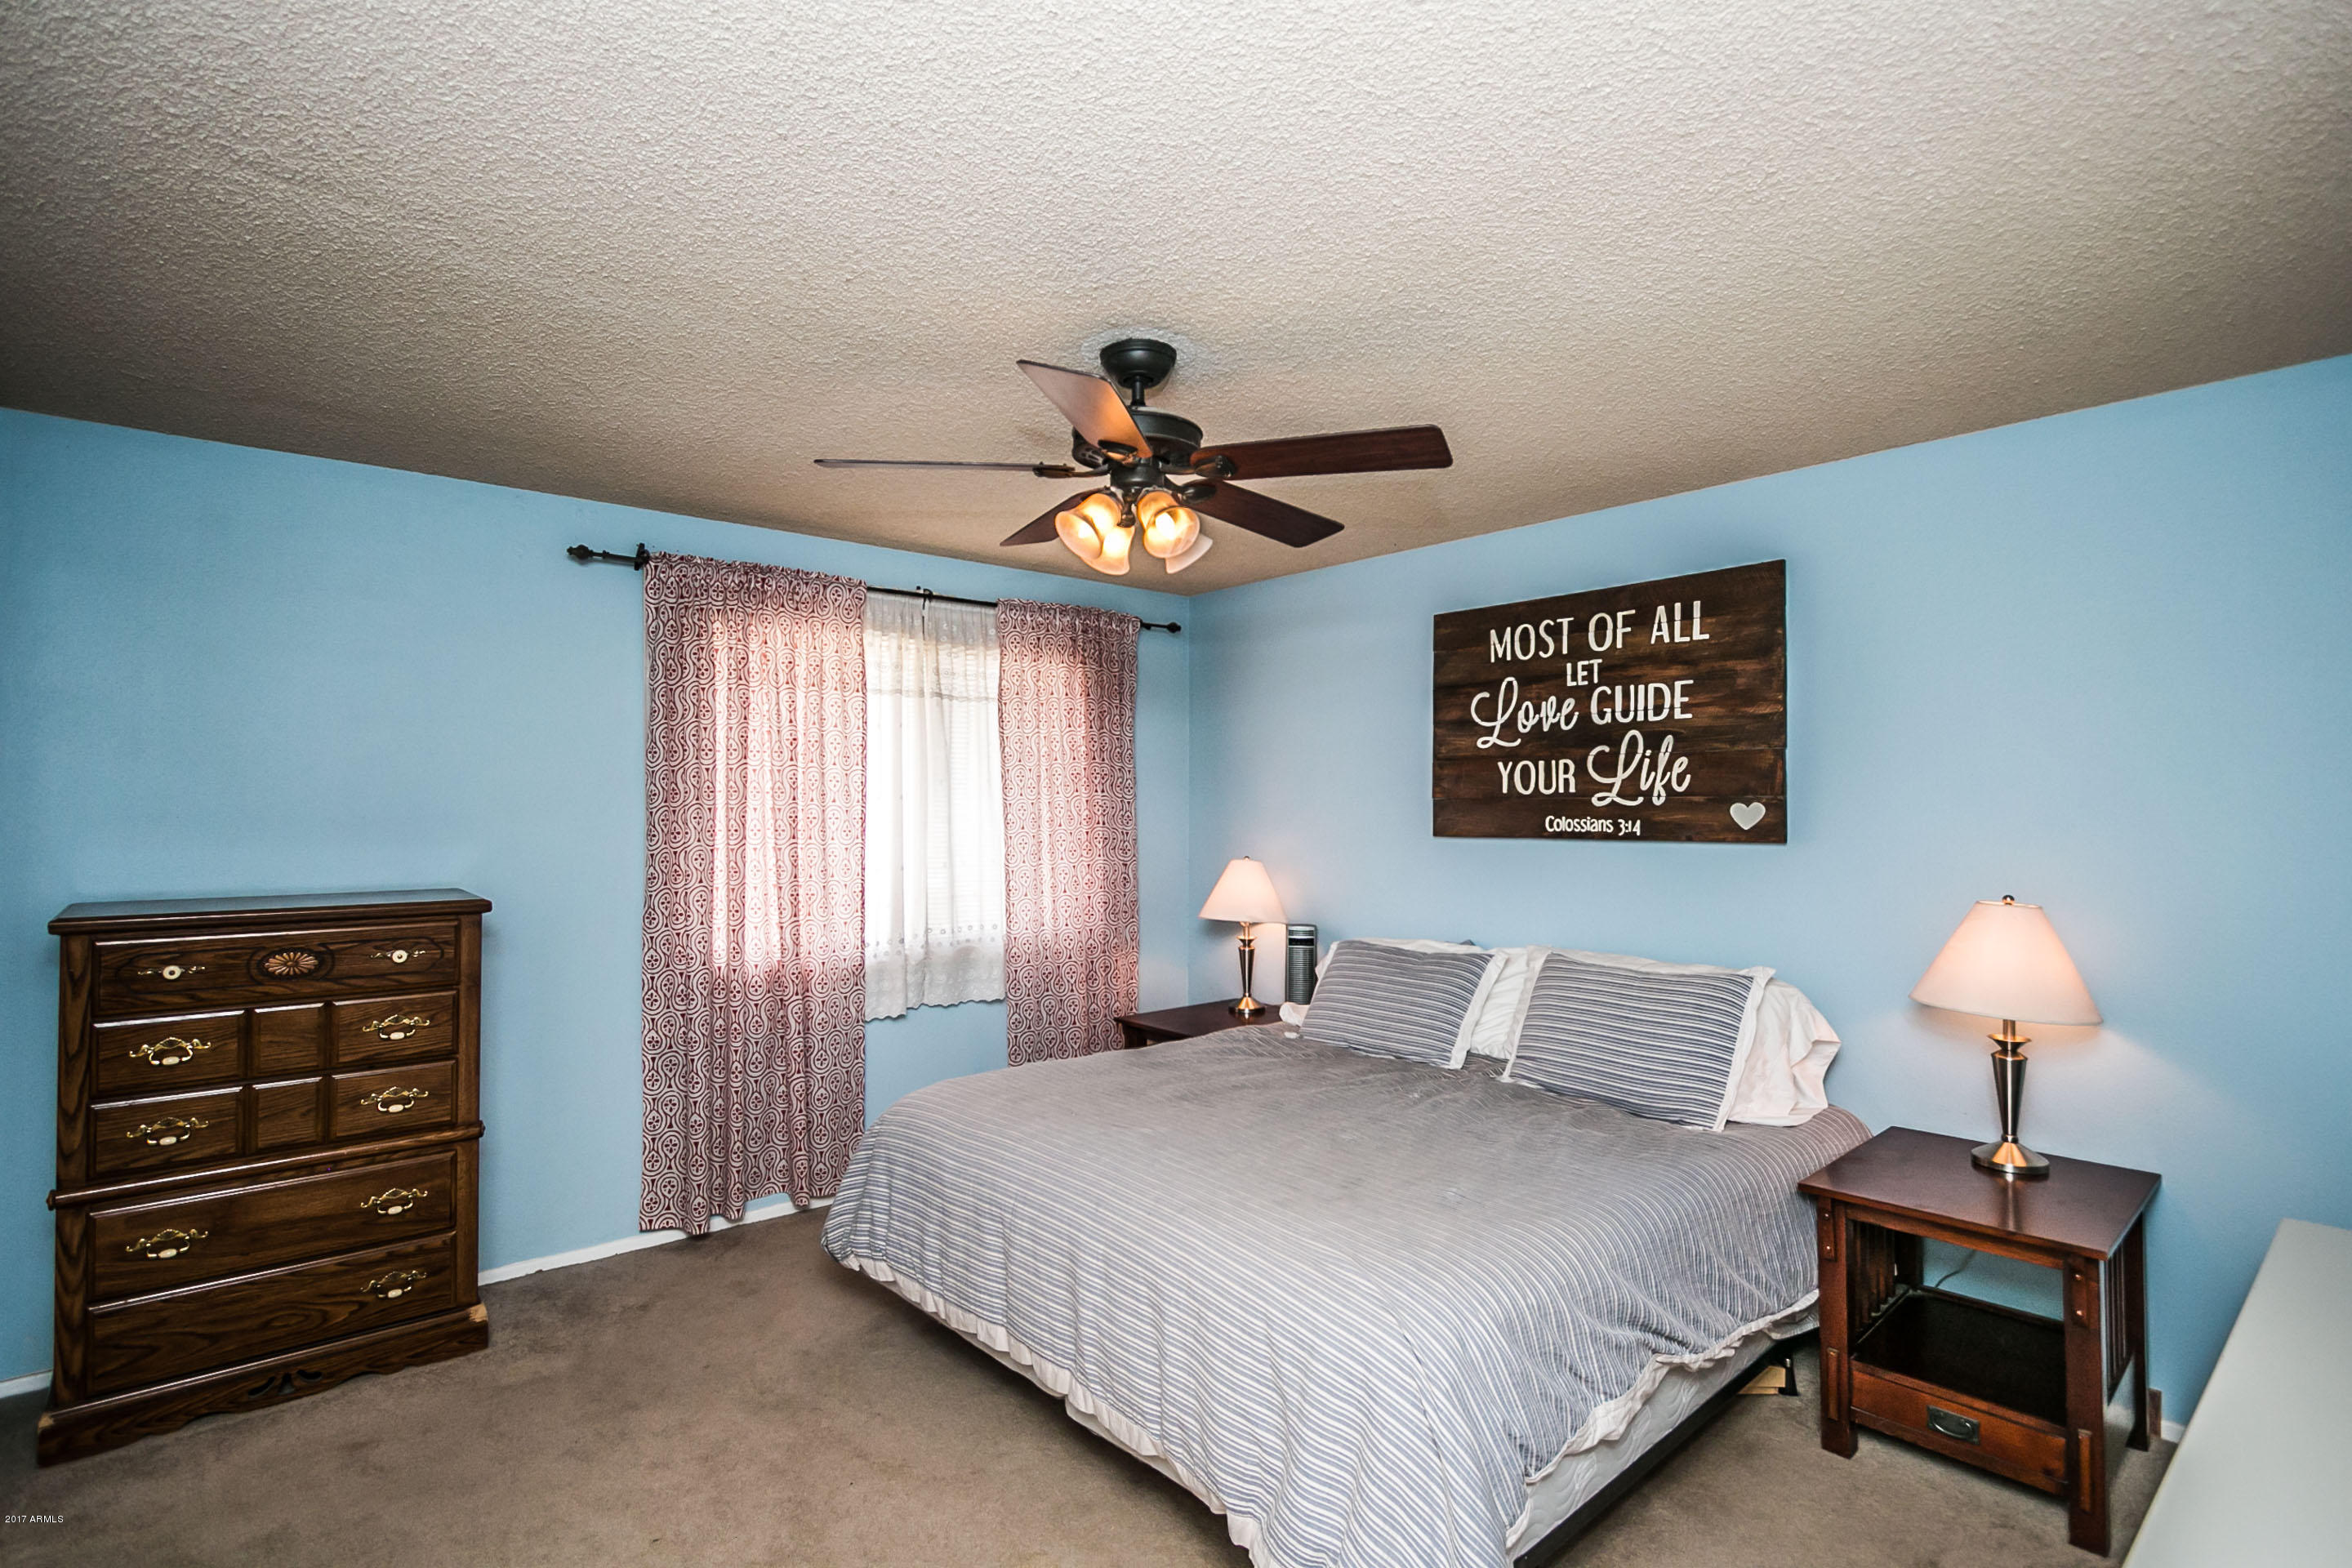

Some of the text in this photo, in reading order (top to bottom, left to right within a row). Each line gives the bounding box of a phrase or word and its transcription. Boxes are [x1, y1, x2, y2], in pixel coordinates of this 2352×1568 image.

[1490, 600, 1710, 663] MOST OF ALL
[1566, 659, 1603, 687] LET
[1470, 677, 1694, 749] Love GUIDE
[1497, 729, 1691, 807] YOUR Life
[1544, 815, 1642, 836] Colossians 3:14
